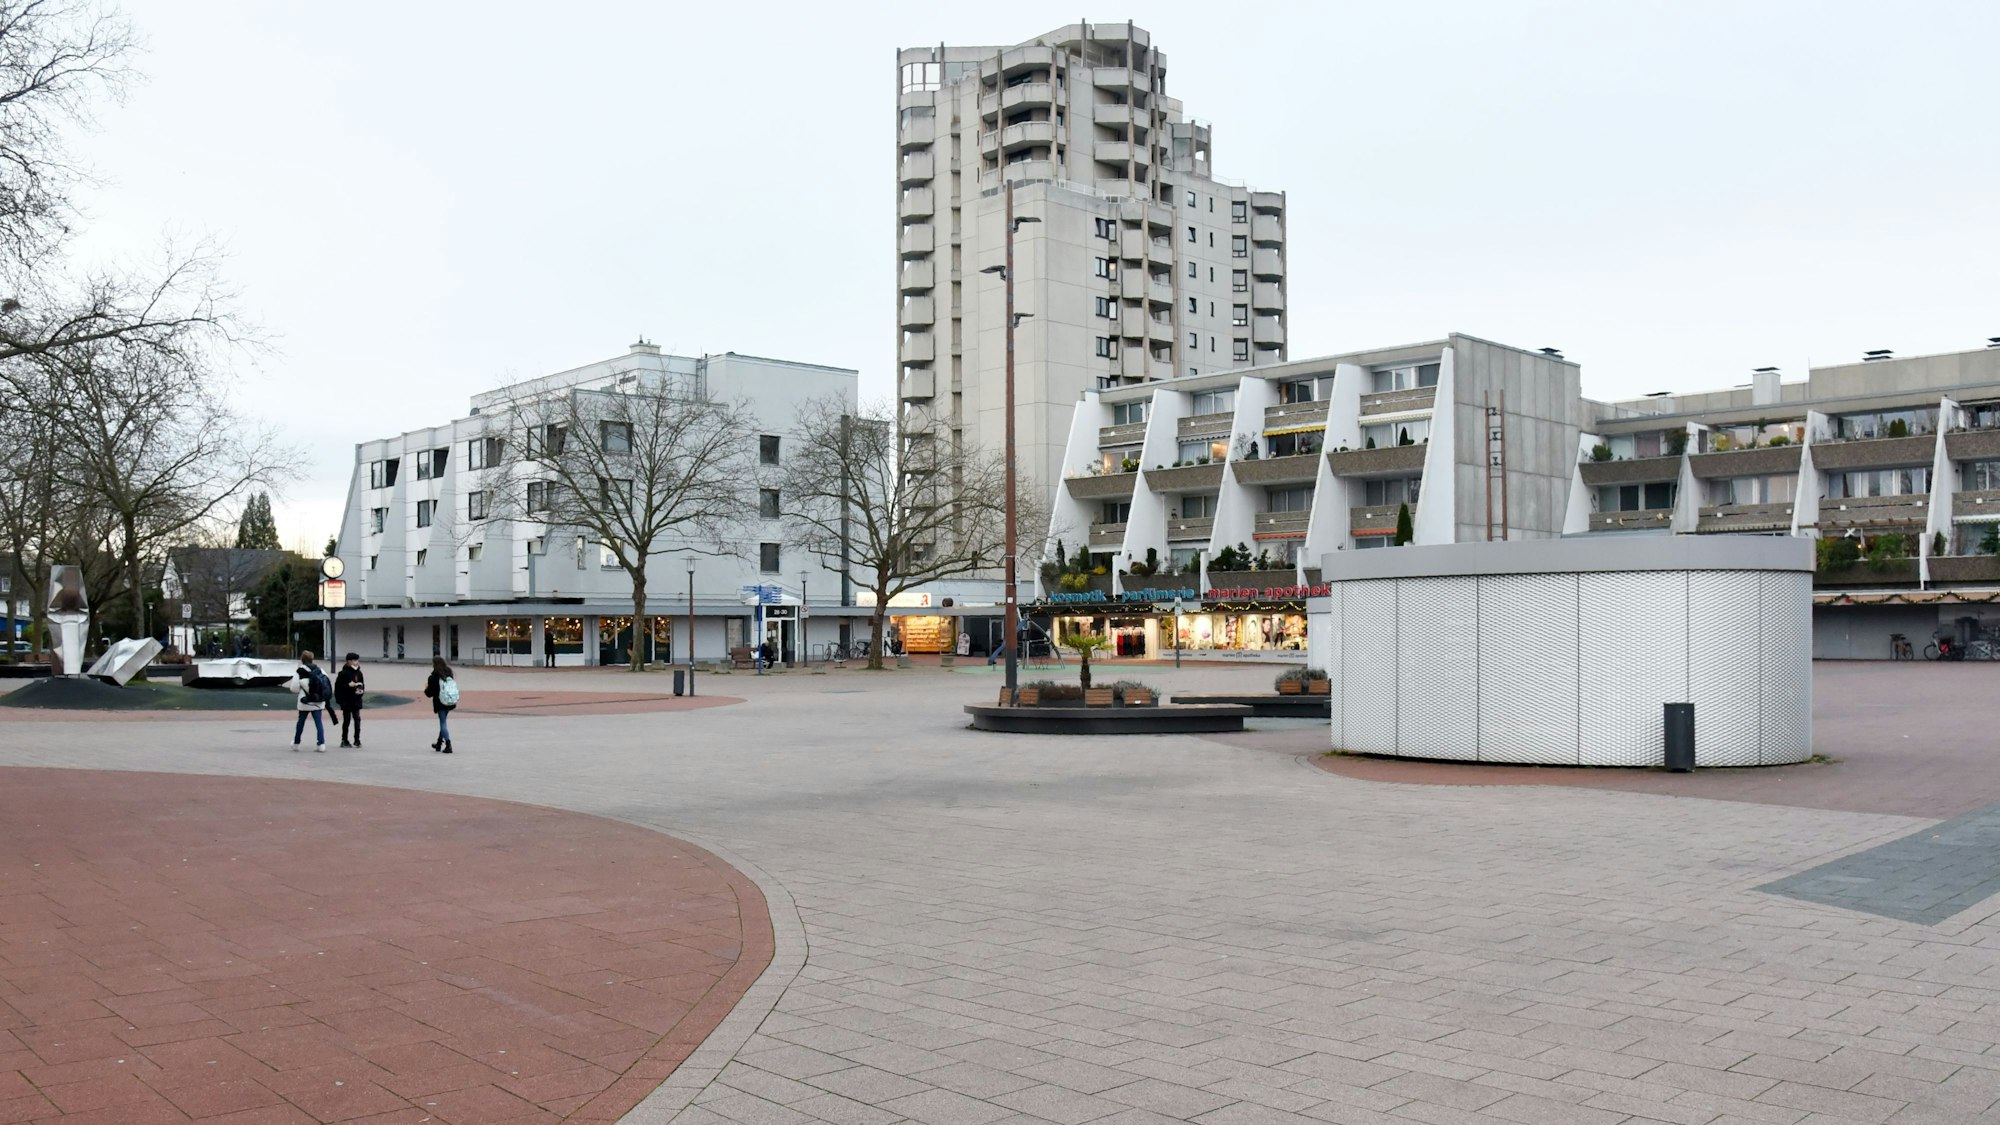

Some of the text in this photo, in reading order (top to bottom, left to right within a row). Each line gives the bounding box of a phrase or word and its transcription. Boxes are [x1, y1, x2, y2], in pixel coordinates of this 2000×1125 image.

[1051, 590, 1106, 602] kosmetik
[1208, 584, 1331, 598] marien apothek
